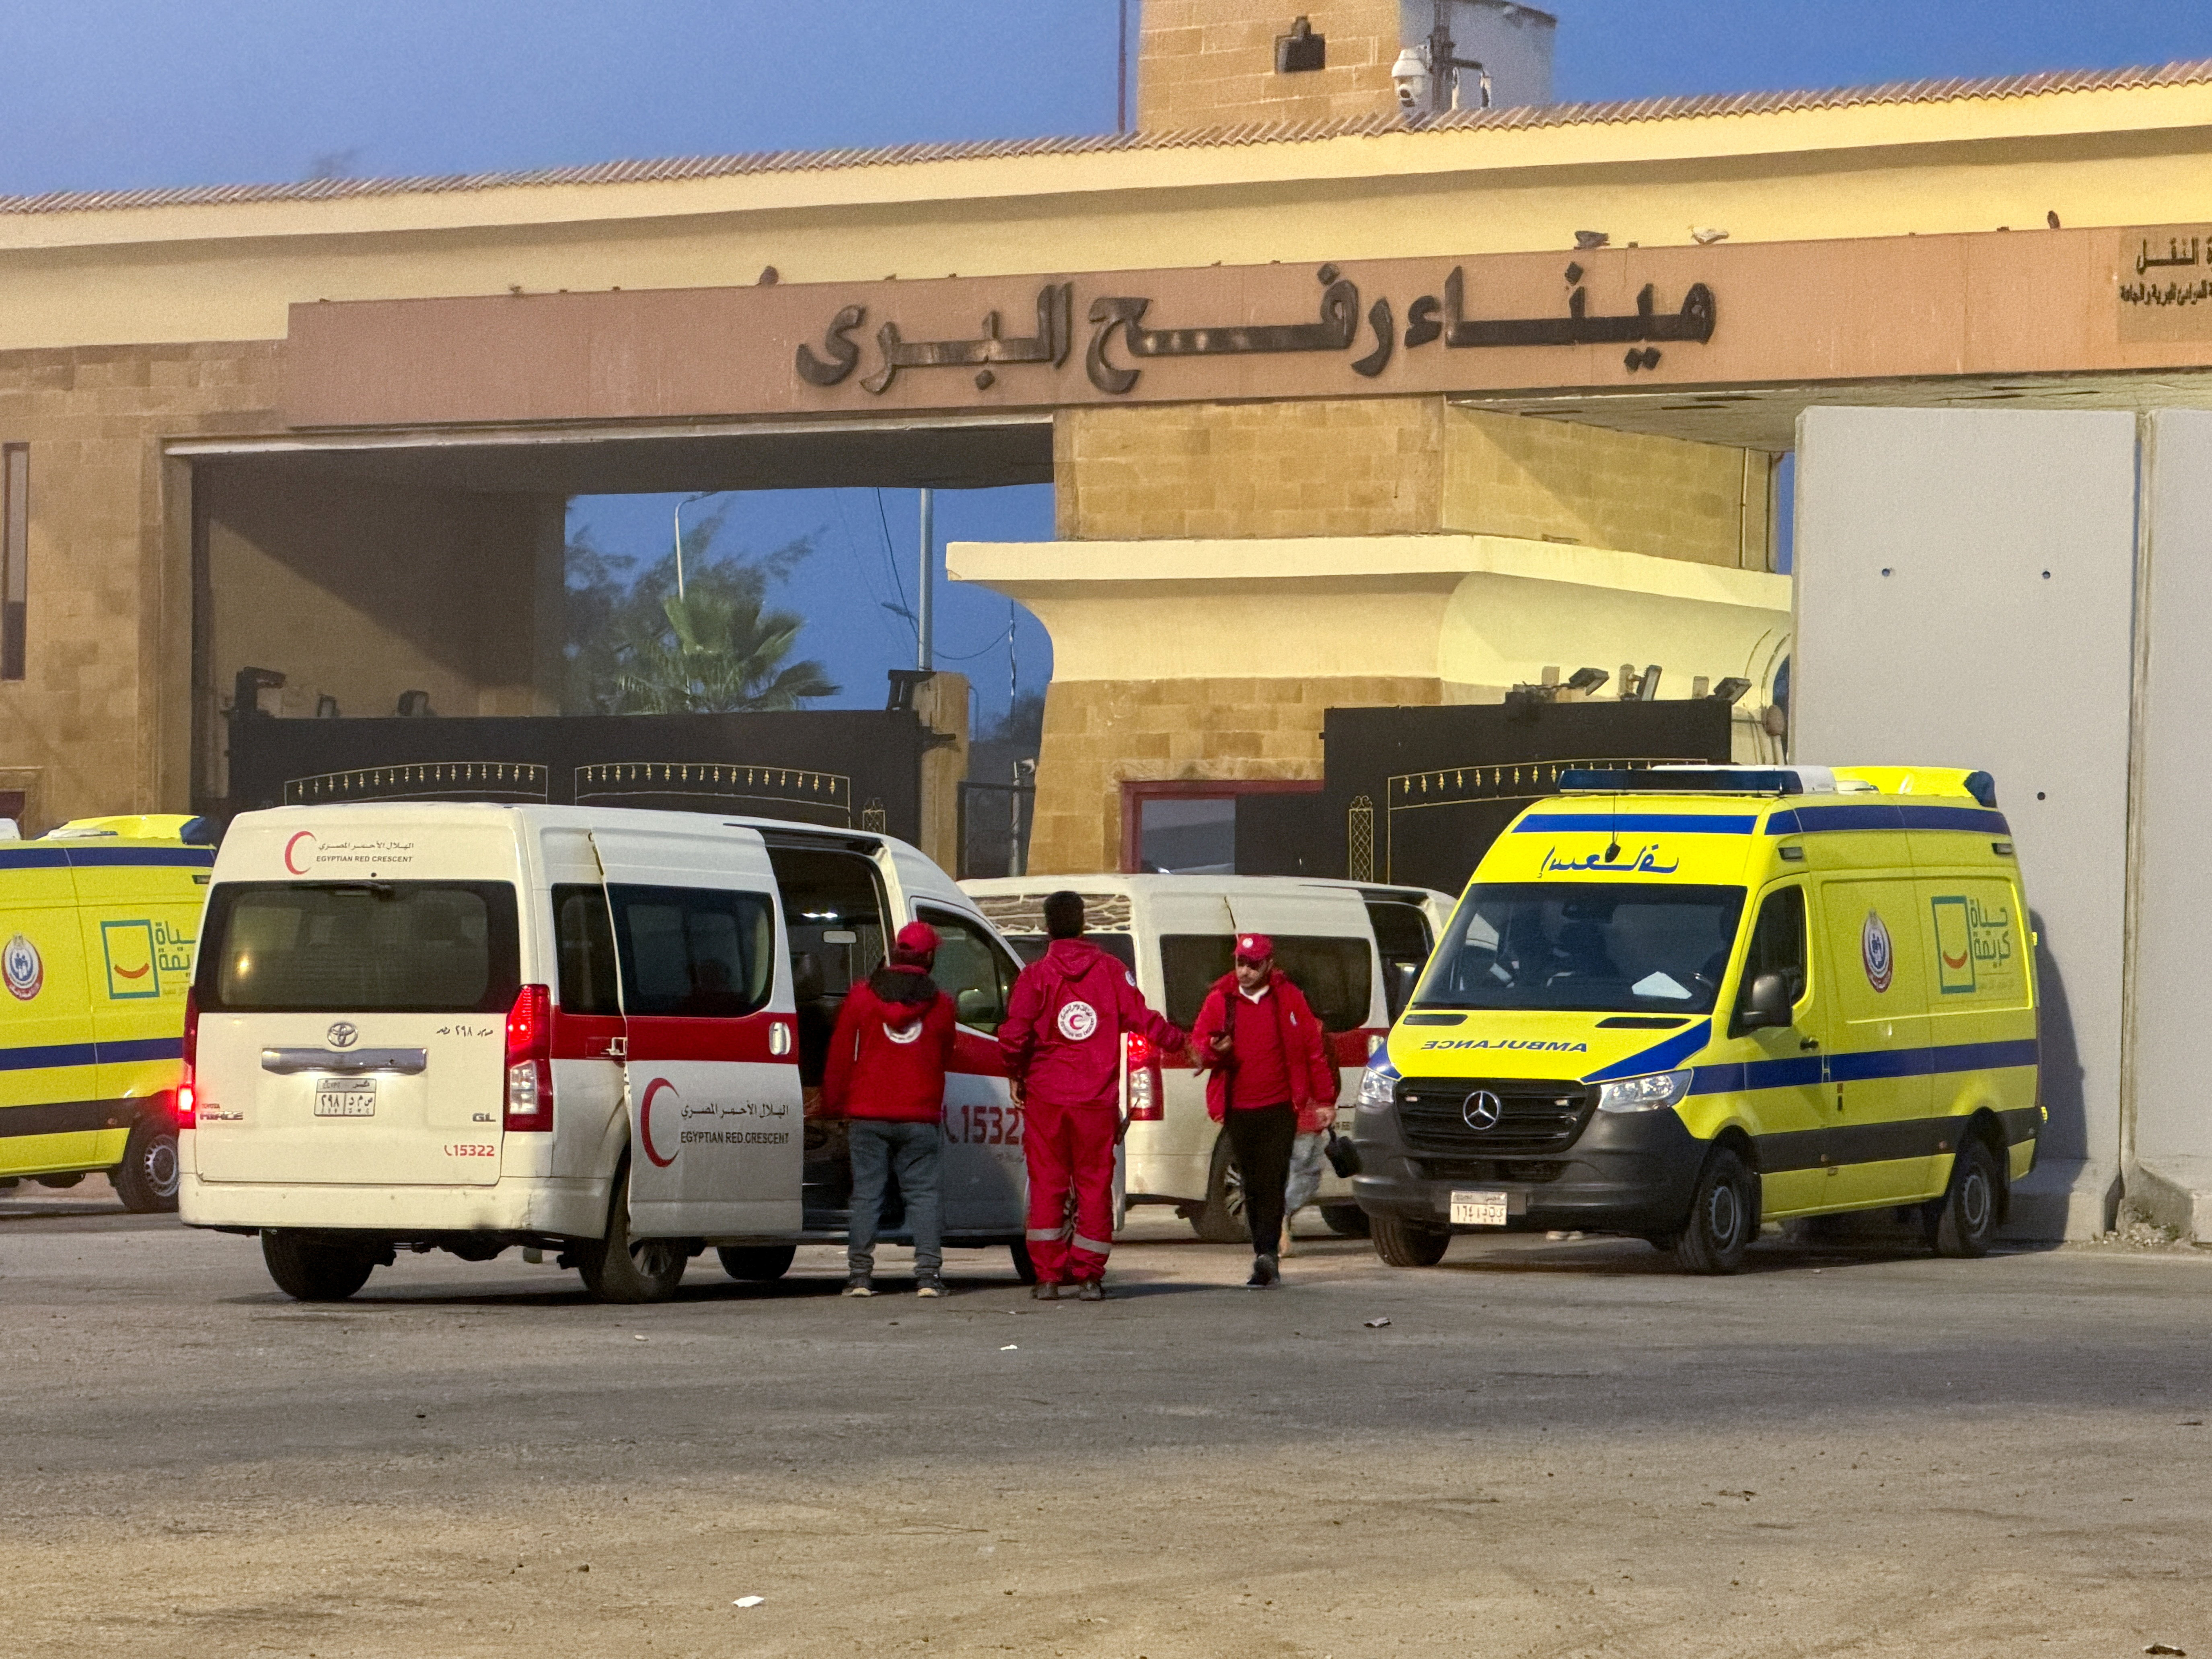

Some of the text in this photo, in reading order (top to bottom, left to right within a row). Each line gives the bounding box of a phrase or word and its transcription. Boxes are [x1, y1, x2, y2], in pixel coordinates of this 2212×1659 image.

[1404, 262, 1716, 372] ميناء
[1086, 263, 1393, 395] رفح
[386, 842, 414, 850] الهلال
[1970, 898, 2008, 935] حياة
[1973, 930, 2011, 968] كريمة
[455, 1025, 472, 1037] ٢٩٨
[472, 1112, 496, 1122] GL
[759, 1103, 789, 1119] الهلال
[961, 1105, 1024, 1145] 1532
[680, 1131, 789, 1144] EGYPTIAN RED CRESCENT
[453, 1145, 495, 1157] 15322
